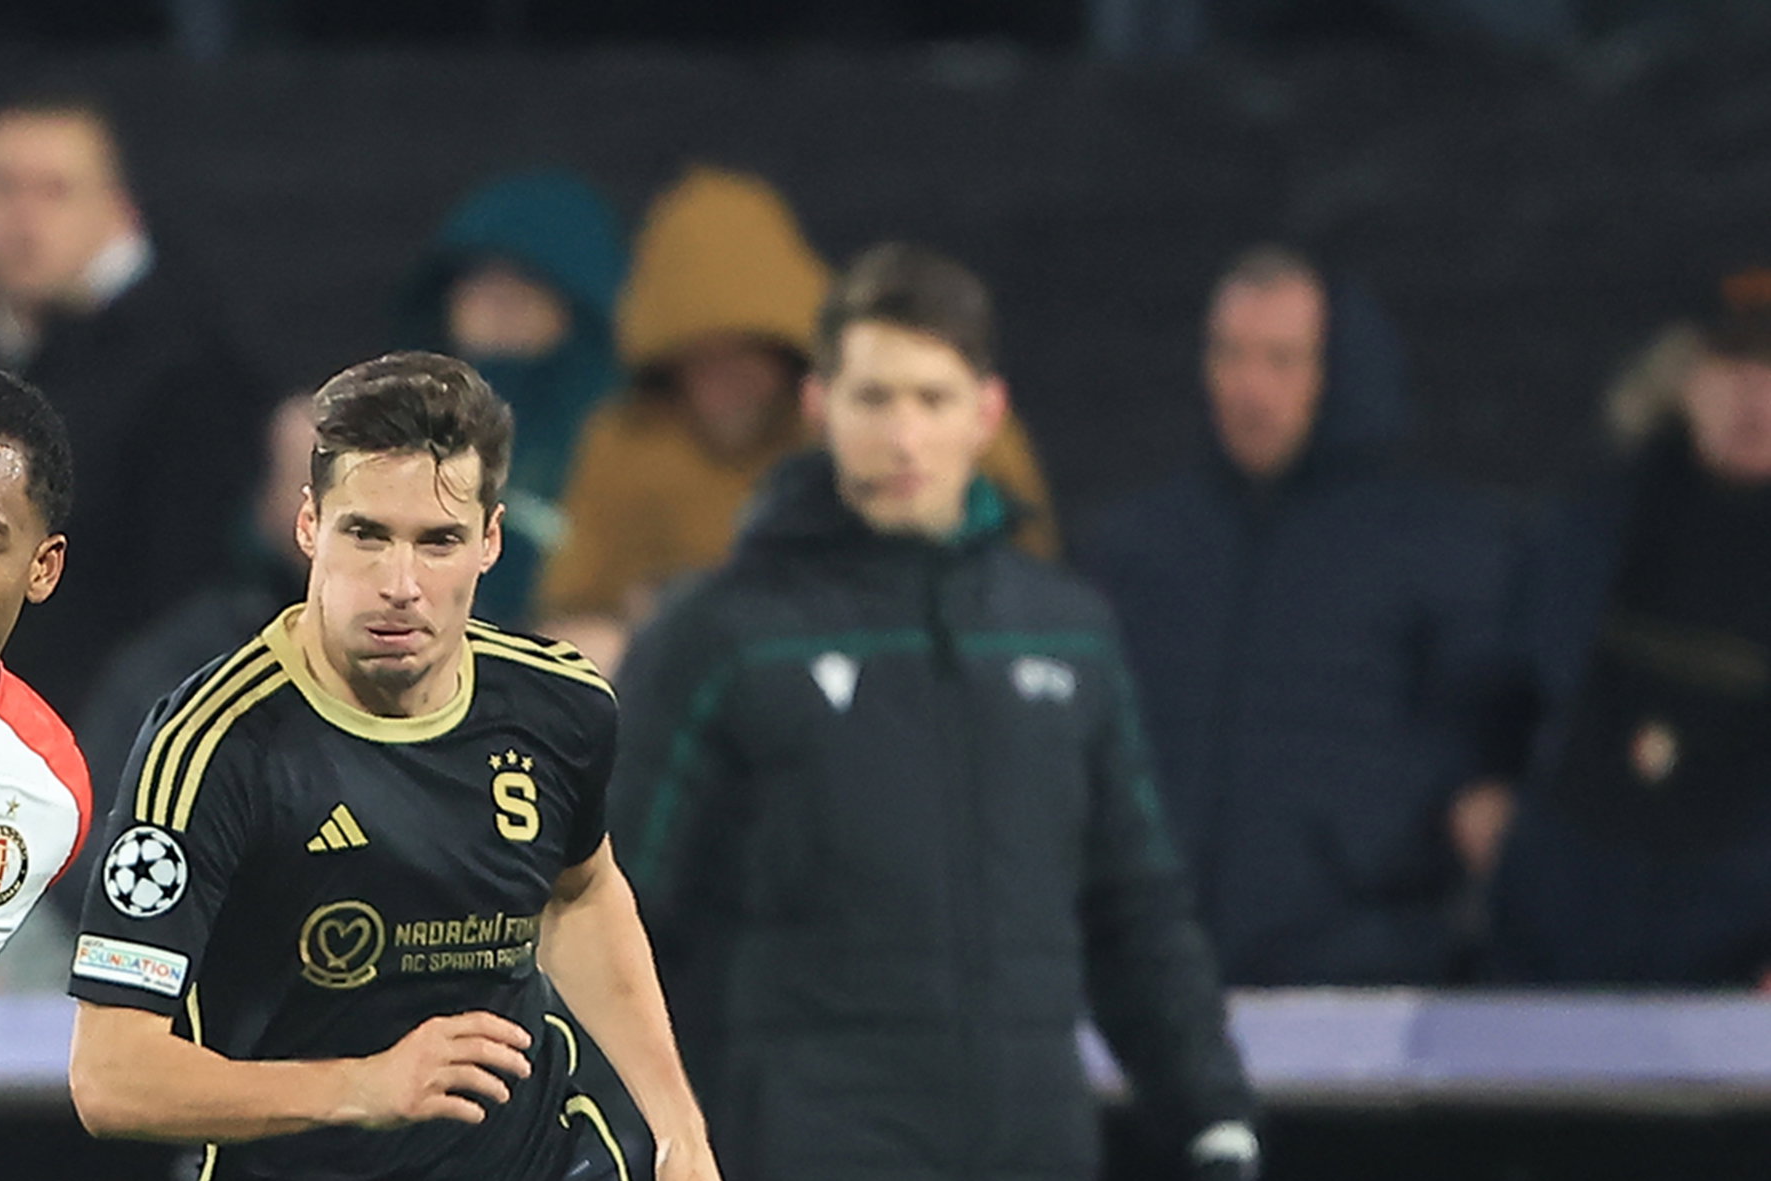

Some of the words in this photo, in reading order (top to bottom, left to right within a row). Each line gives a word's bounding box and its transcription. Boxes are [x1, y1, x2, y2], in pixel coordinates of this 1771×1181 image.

[492, 771, 540, 842] S
[394, 911, 504, 947] NADAČNÍ
[78, 946, 182, 981] FOUNDATION
[400, 953, 426, 972] AC
[428, 949, 495, 972] SPARTA
